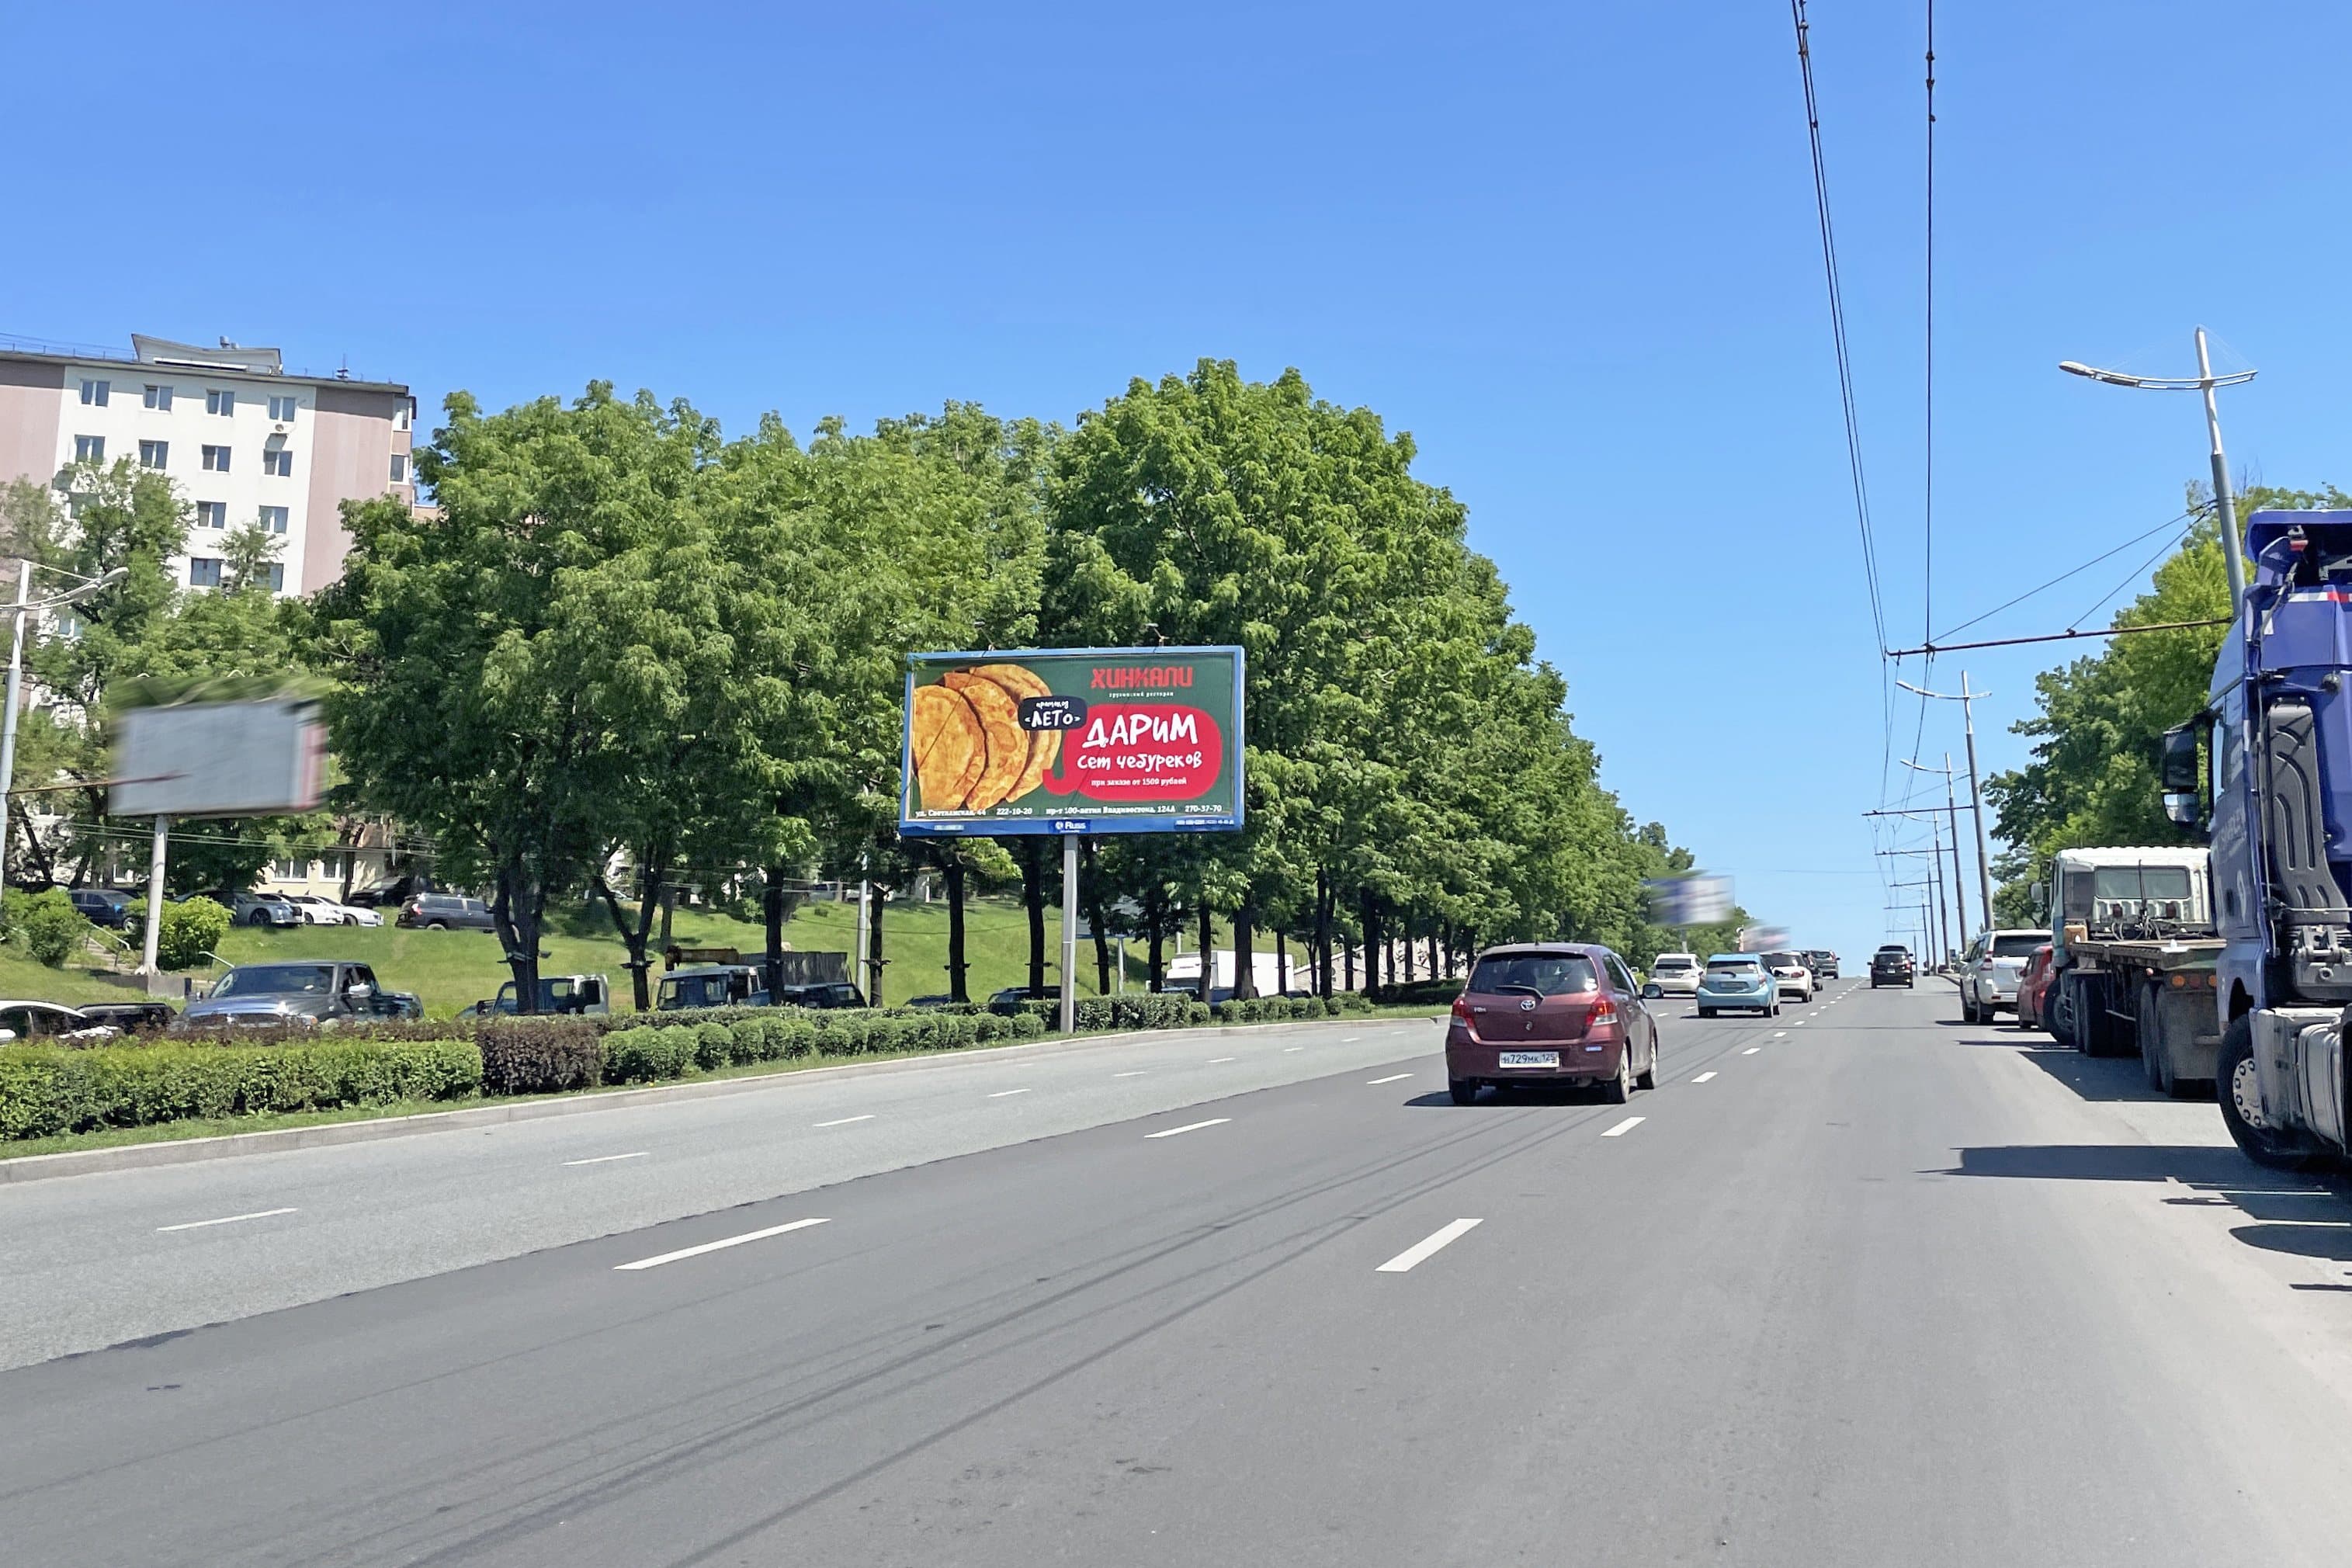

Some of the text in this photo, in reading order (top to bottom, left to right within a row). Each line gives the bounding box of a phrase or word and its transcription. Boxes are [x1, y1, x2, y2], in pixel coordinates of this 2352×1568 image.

[1091, 666, 1193, 689] ХИНКАЛИ
[1036, 700, 1069, 709] промокод
[1082, 713, 1199, 748] ДАРИМ
[1116, 751, 1202, 772] чебуреков
[1143, 777, 1160, 786] 1500
[1160, 777, 1187, 786] рублей
[996, 807, 1033, 816] 222-10-20
[1185, 804, 1223, 813] 270-37-70
